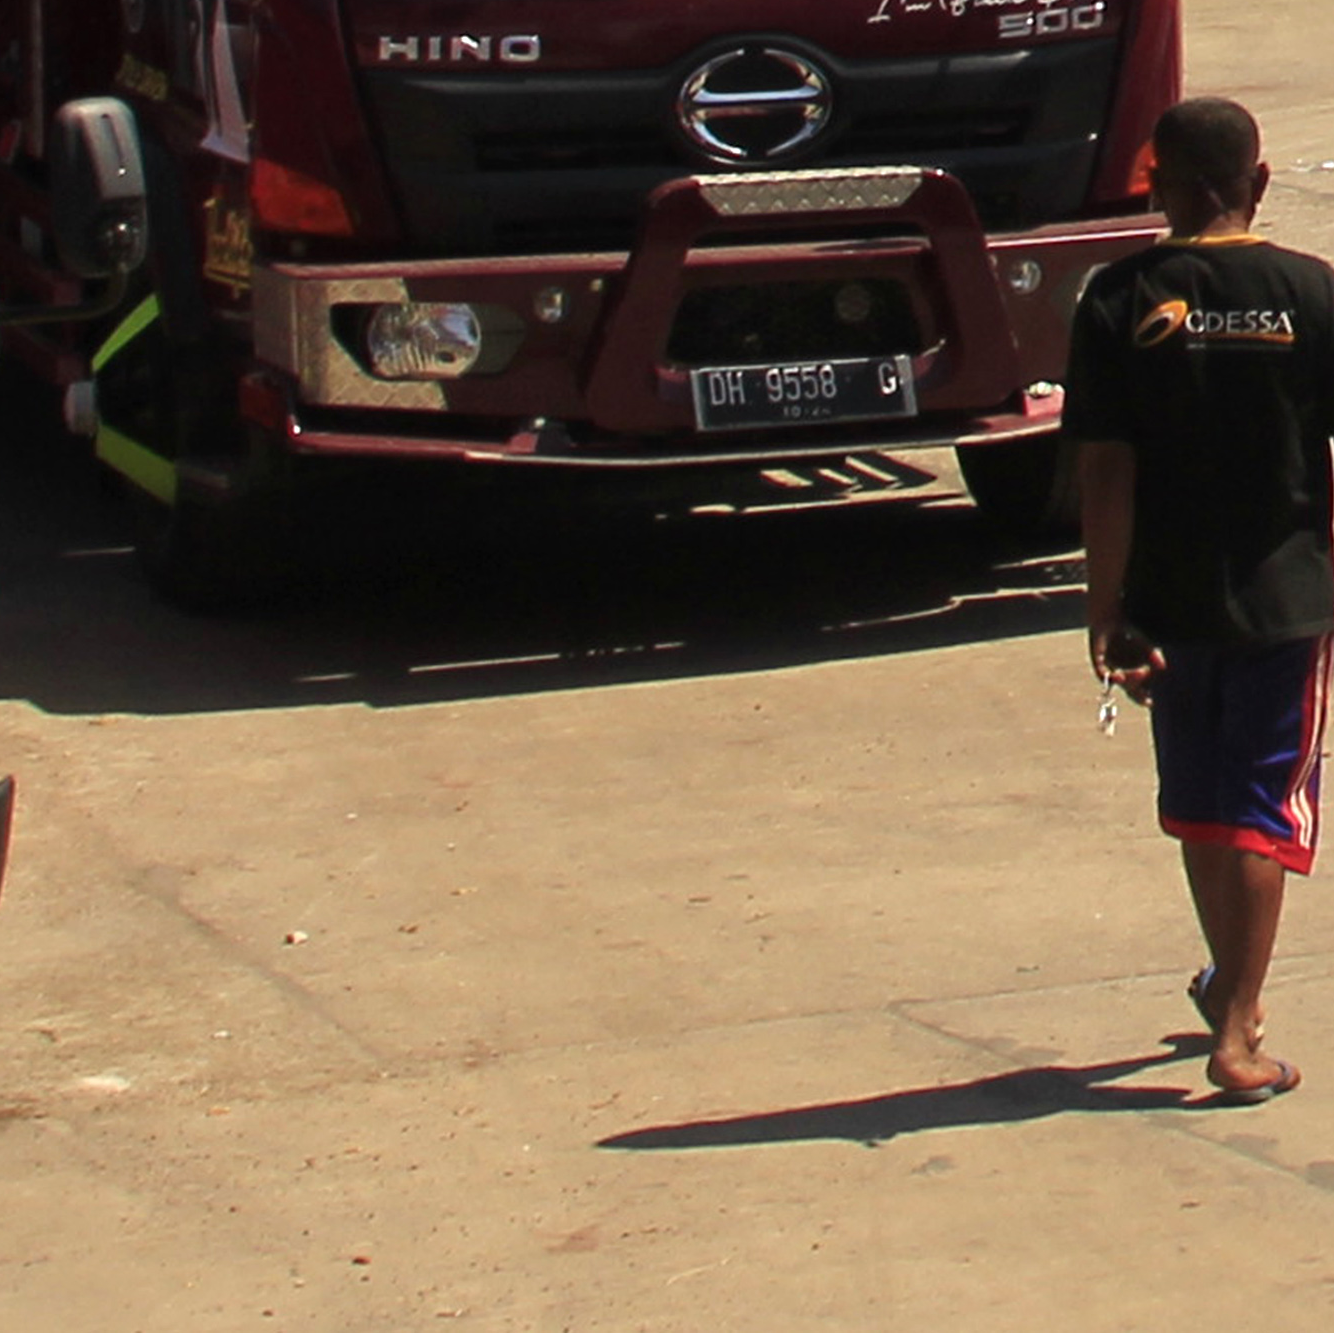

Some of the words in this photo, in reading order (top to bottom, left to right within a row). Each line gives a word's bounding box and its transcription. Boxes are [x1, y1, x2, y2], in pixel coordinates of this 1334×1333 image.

[998, 2, 1107, 38] 500
[378, 35, 541, 62] HINO
[708, 371, 746, 406] DH
[766, 363, 837, 403] 9558
